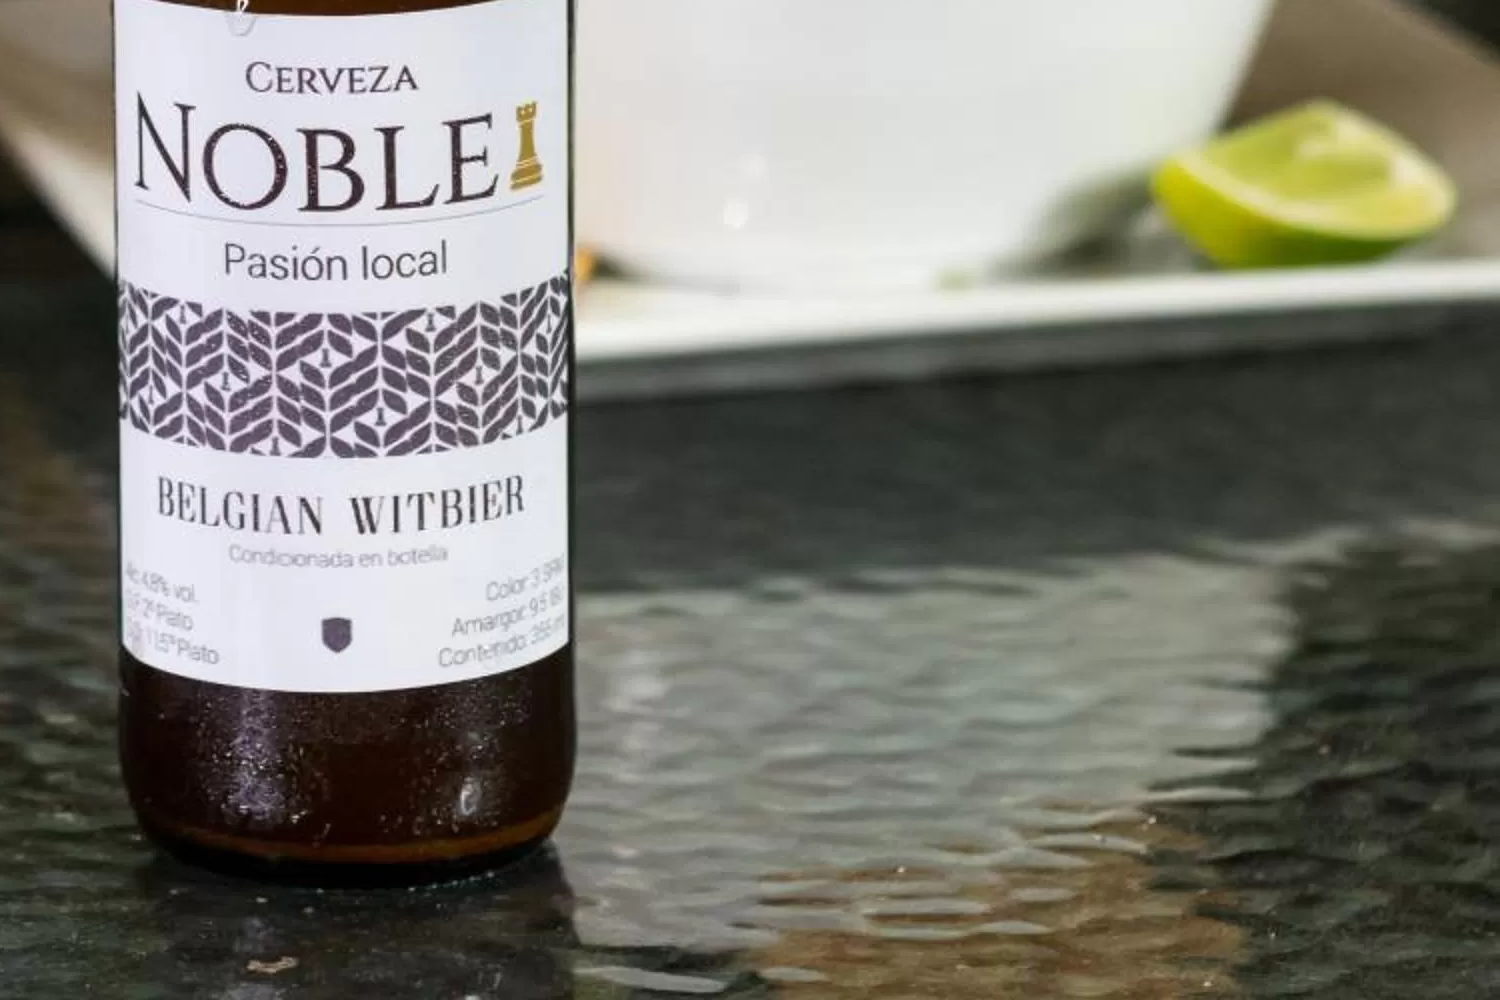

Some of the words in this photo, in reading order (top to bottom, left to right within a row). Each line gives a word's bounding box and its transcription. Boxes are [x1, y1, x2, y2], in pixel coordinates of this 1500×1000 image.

[245, 61, 420, 95] CERVEZA
[134, 90, 499, 213] NOBLE
[224, 242, 348, 281] Pasión
[362, 240, 447, 282] local
[157, 475, 324, 536] BELGIAN
[350, 473, 526, 536] WITBIER
[228, 543, 354, 569] Condicionada
[359, 552, 383, 567] en
[387, 544, 449, 567] botella
